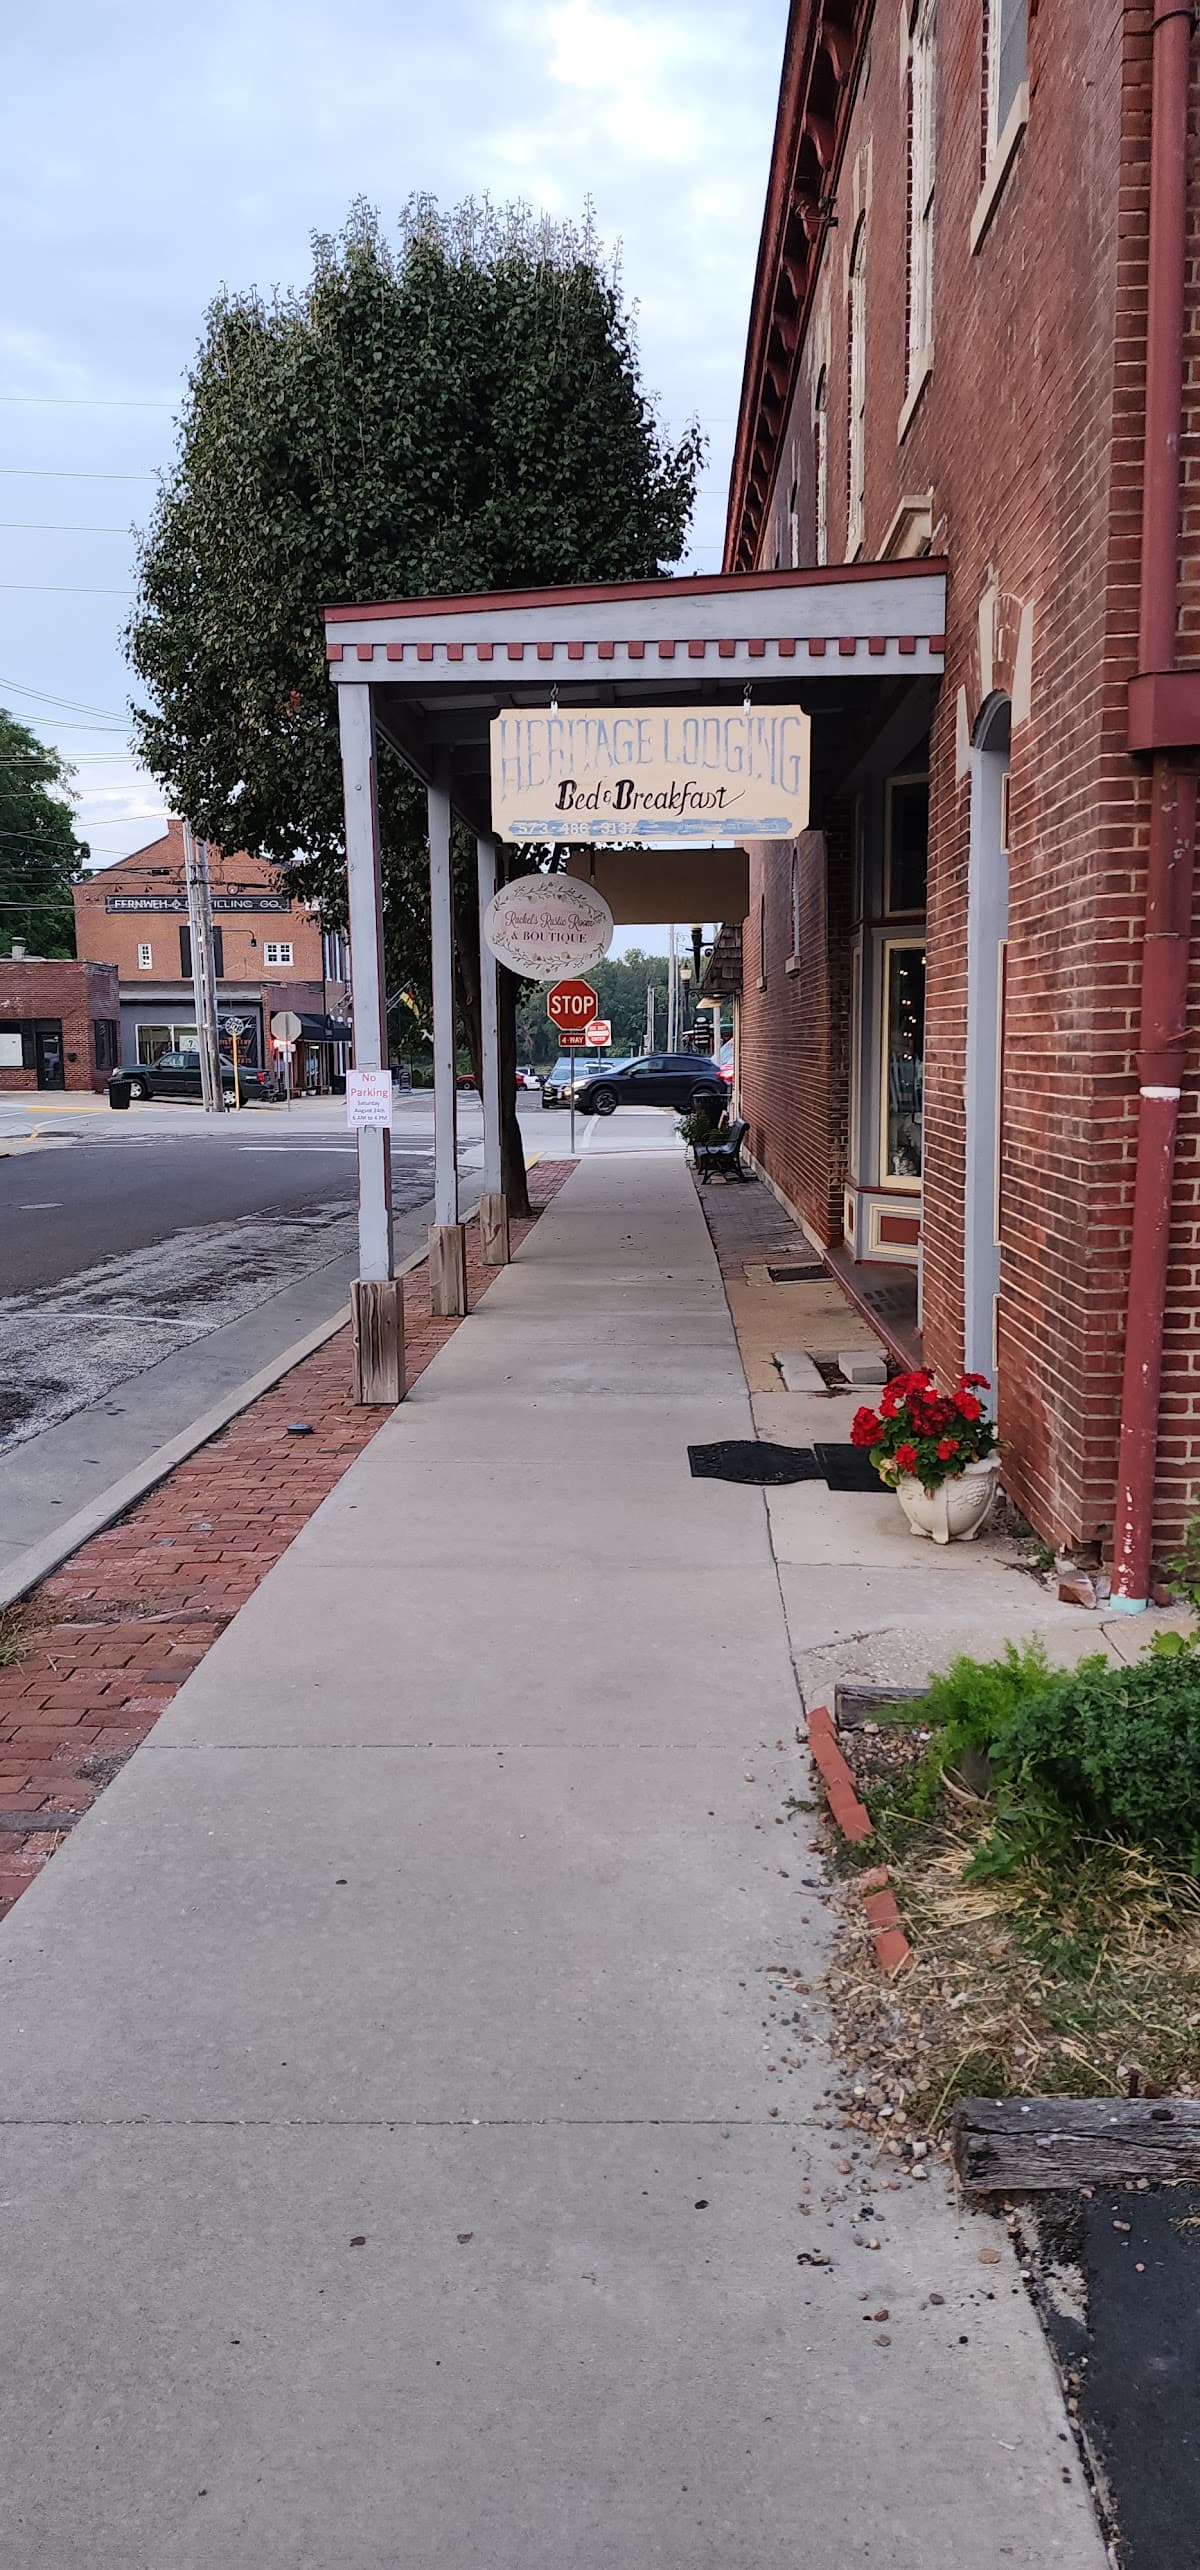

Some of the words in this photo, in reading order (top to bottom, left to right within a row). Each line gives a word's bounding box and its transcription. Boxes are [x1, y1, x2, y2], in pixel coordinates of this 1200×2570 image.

[500, 717, 653, 803] HERITAGE
[663, 715, 802, 795] LODGING
[555, 779, 602, 810] Bed
[612, 779, 746, 816] Breakfast
[114, 899, 168, 909] FERNWEH
[505, 910, 538, 928] Rachel's
[540, 912, 566, 930] Rustic
[511, 931, 518, 940] &
[523, 931, 587, 944] BOUTIQUE
[551, 995, 594, 1015] STOP
[561, 1036, 584, 1044] 4-WAY
[362, 1073, 377, 1082] No
[350, 1087, 389, 1099] Parking
